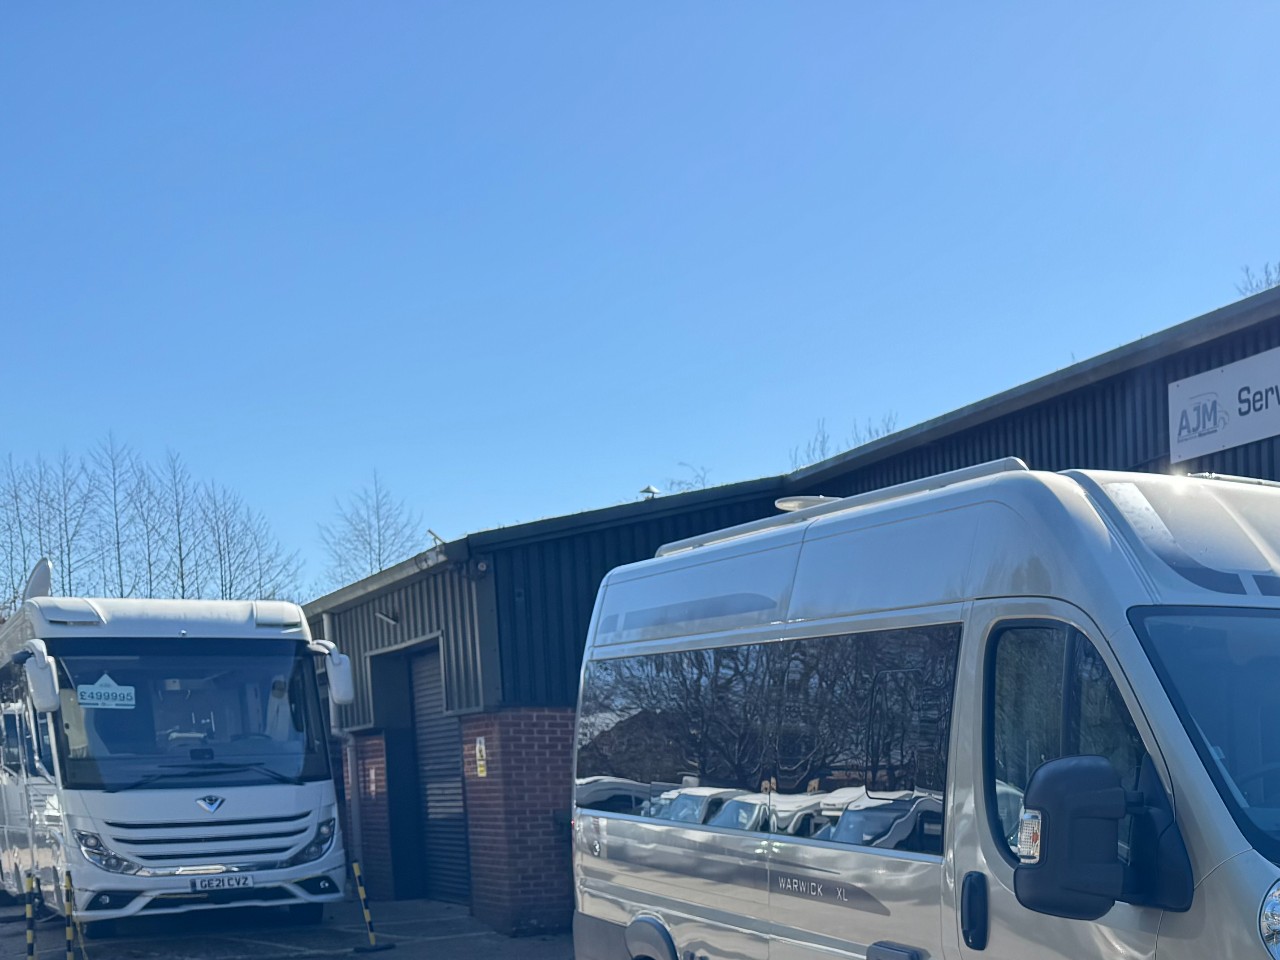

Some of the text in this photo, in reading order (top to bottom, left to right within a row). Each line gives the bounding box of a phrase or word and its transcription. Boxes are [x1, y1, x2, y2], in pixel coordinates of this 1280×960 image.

[1177, 400, 1217, 436] AJM
[778, 876, 849, 901] WARWICK XL
